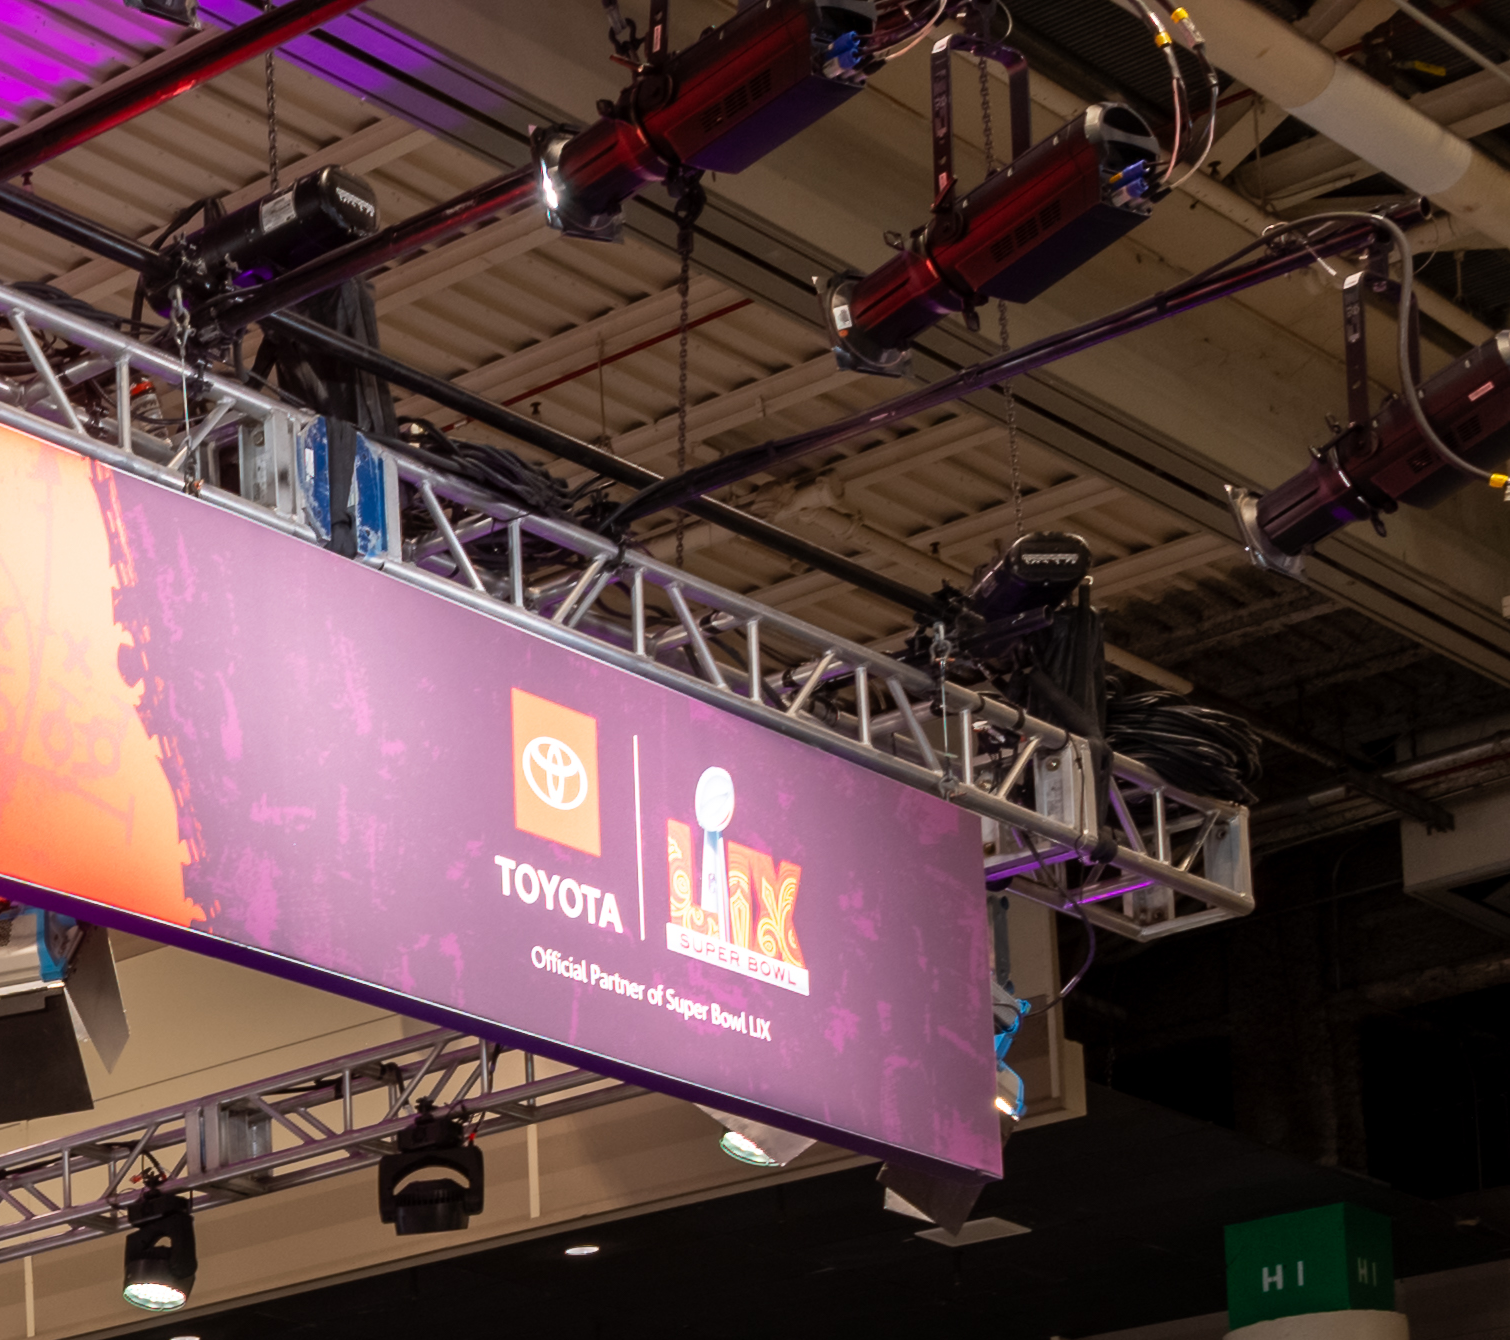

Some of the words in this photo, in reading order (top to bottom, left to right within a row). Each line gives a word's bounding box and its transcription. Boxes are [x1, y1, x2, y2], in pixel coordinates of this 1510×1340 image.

[494, 855, 624, 934] TOYOTA
[531, 946, 588, 985] Official
[590, 965, 646, 1001] Partner
[647, 985, 665, 1007] of
[665, 988, 709, 1022] Super
[711, 1003, 748, 1035] Bowl
[749, 1015, 773, 1042] LIX
[679, 933, 742, 968] SUPER
[748, 959, 798, 987] BOWL
